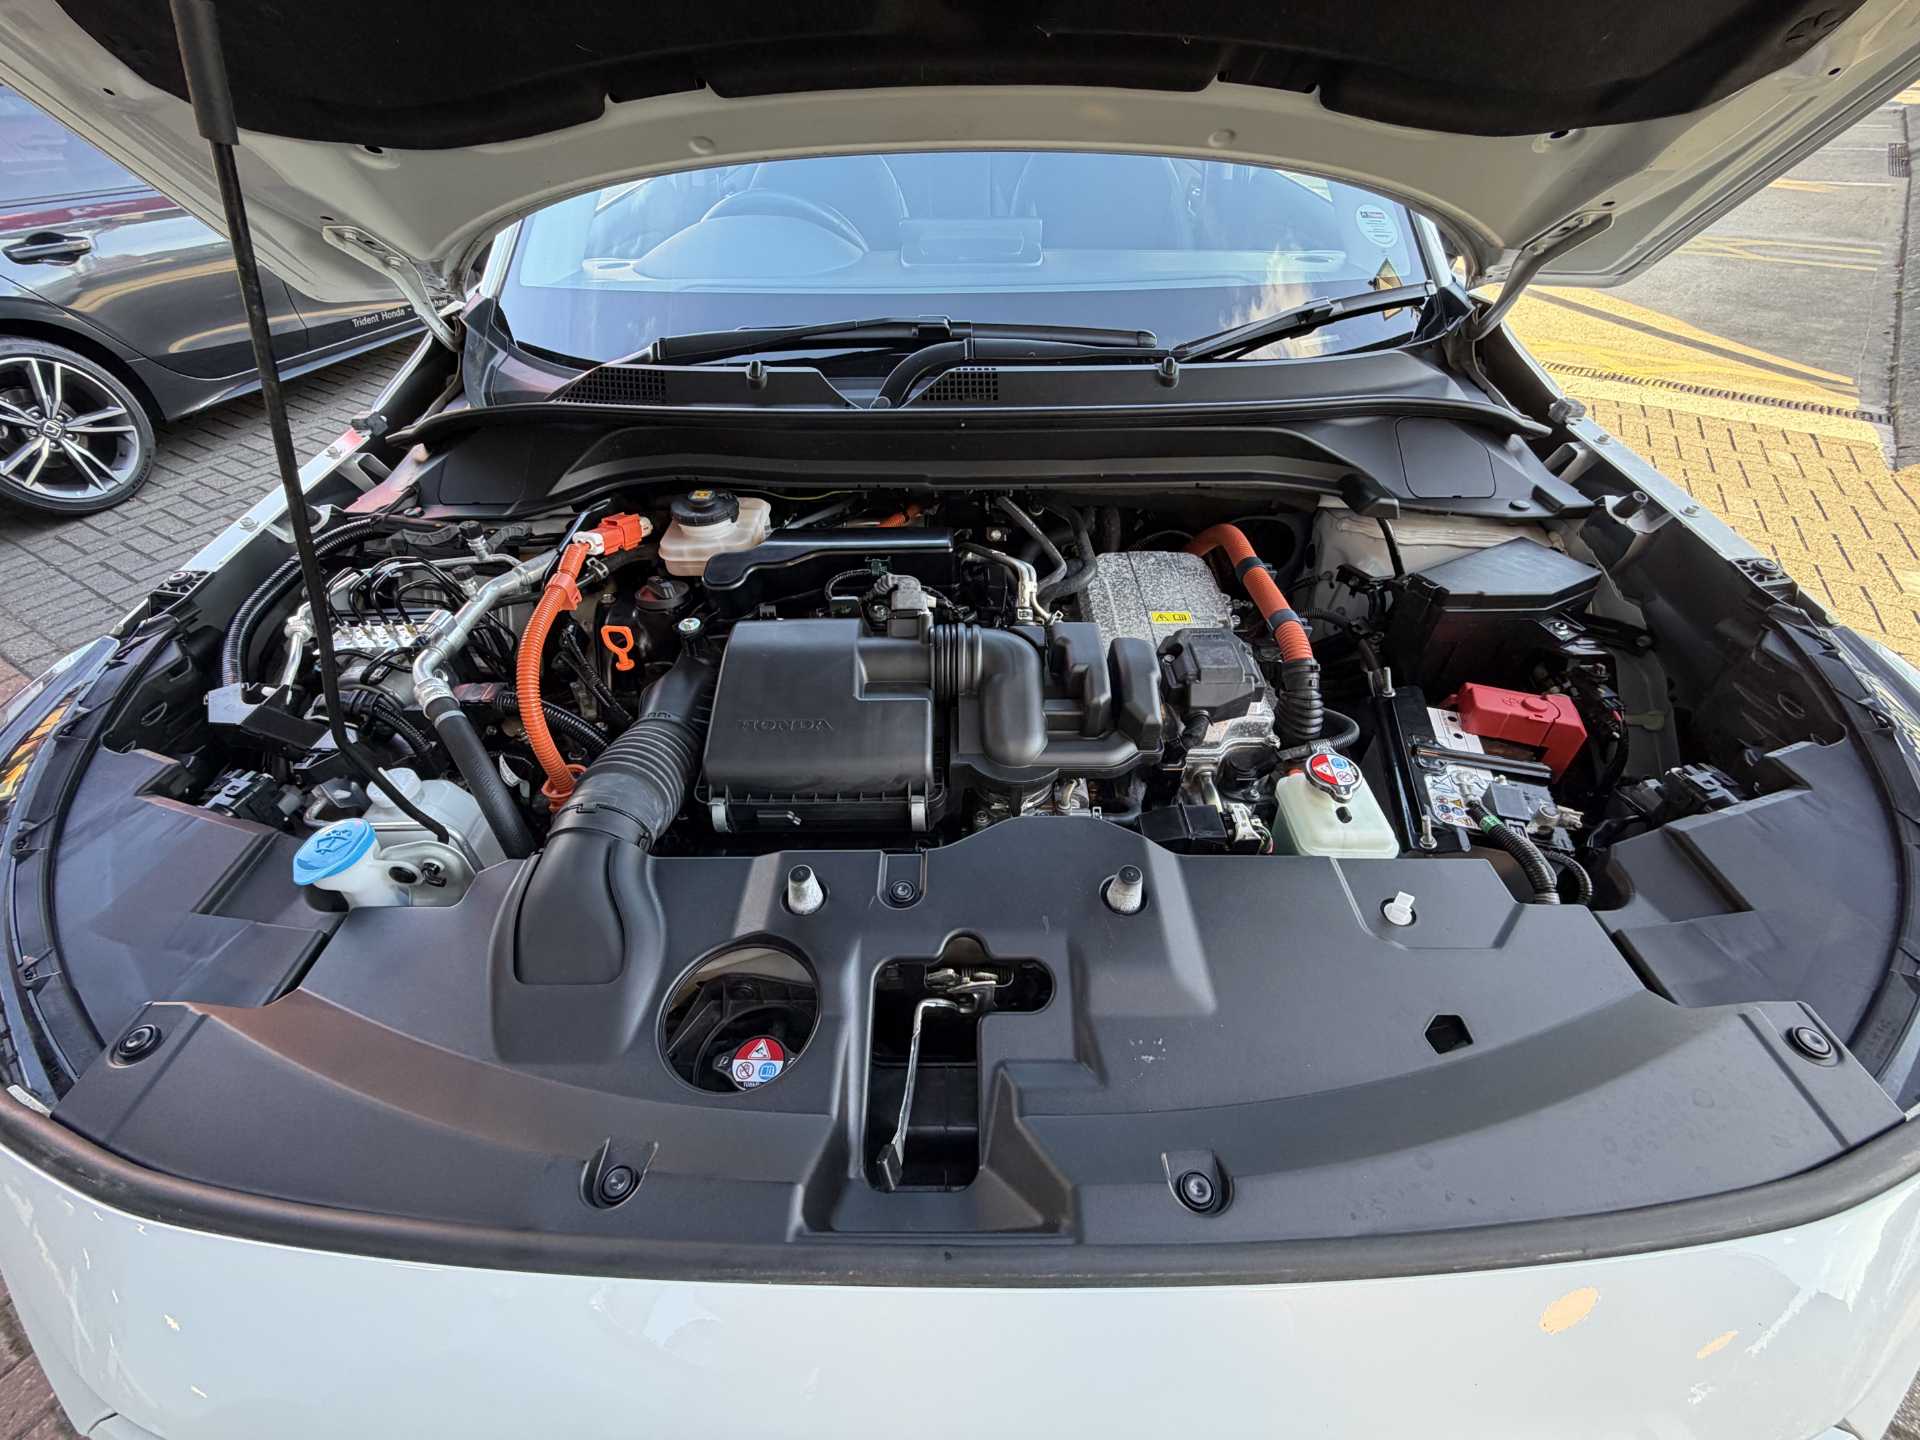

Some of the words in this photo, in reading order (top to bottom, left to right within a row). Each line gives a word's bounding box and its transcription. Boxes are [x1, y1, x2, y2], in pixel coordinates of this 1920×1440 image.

[352, 314, 379, 327] Trident
[381, 307, 405, 320] Honda
[737, 719, 834, 732] HONDA
